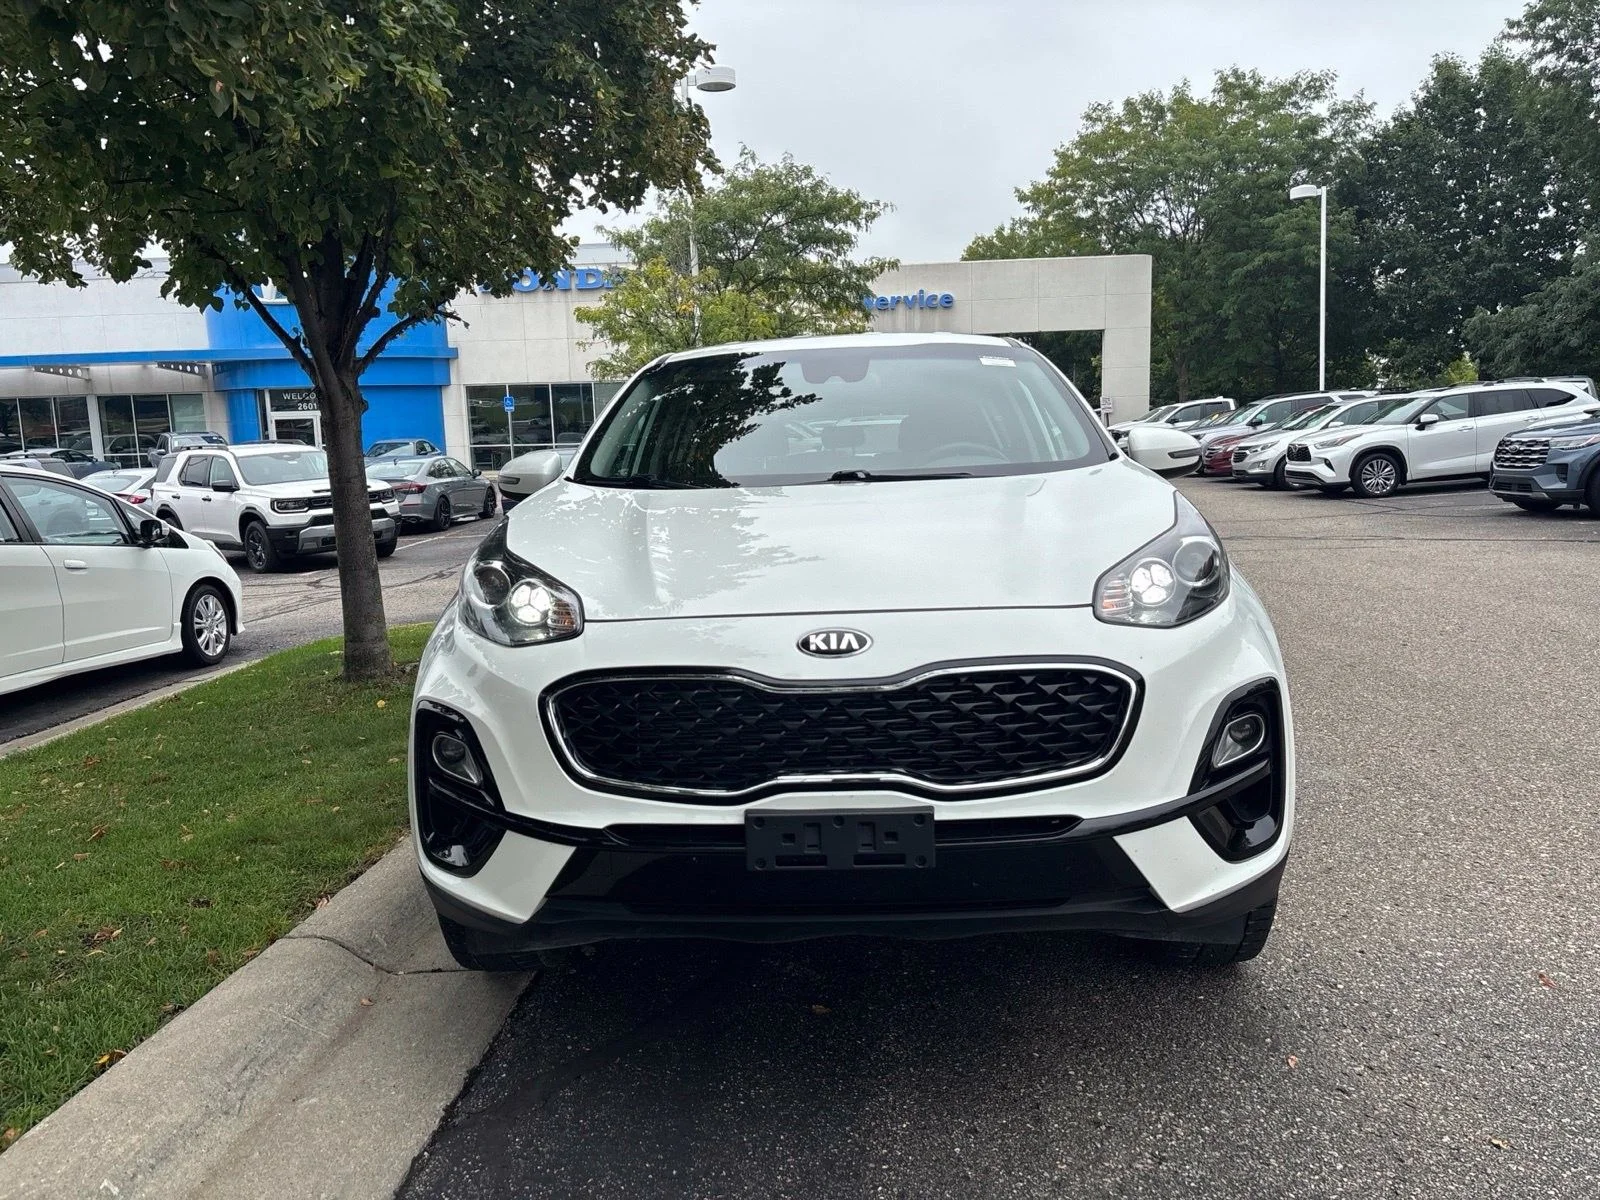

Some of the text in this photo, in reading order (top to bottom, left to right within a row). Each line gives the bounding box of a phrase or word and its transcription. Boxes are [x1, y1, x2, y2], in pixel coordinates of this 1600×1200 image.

[479, 267, 616, 292] OND
[297, 402, 317, 411] 2601
[809, 632, 860, 651] KIA
